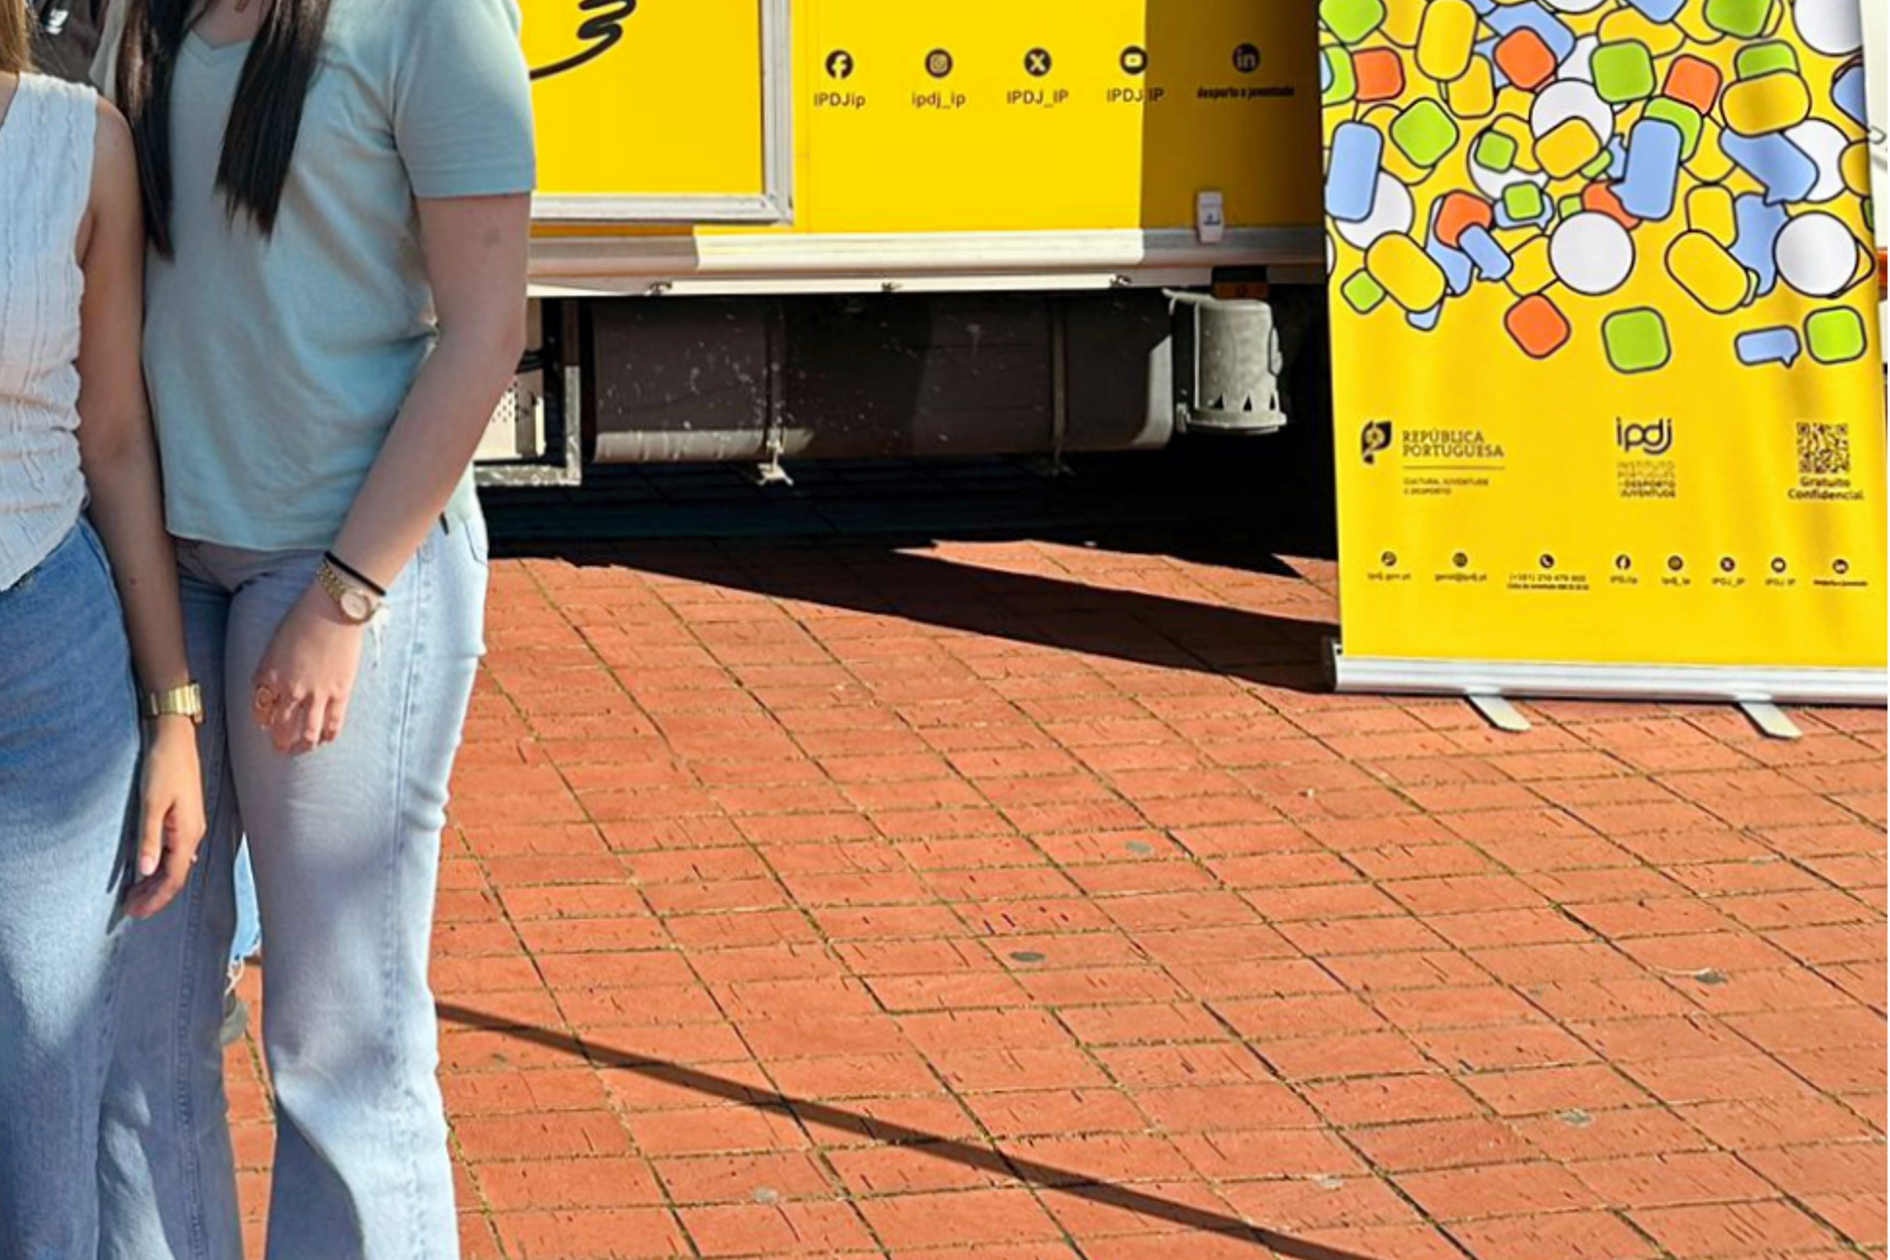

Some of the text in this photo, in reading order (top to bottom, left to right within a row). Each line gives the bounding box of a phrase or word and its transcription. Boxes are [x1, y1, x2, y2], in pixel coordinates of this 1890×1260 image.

[814, 92, 866, 109] IPDJip
[912, 91, 966, 109] ipdj_ip
[1007, 90, 1069, 108] IPDJ_IP
[1107, 87, 1164, 102] IPDJIP
[1402, 427, 1484, 444] REPÚBLICA
[1616, 416, 1672, 455] ipdj
[1402, 444, 1505, 458] PORTUGUESA
[1800, 476, 1851, 487] Gratuito
[1787, 488, 1865, 501] Confidencial
